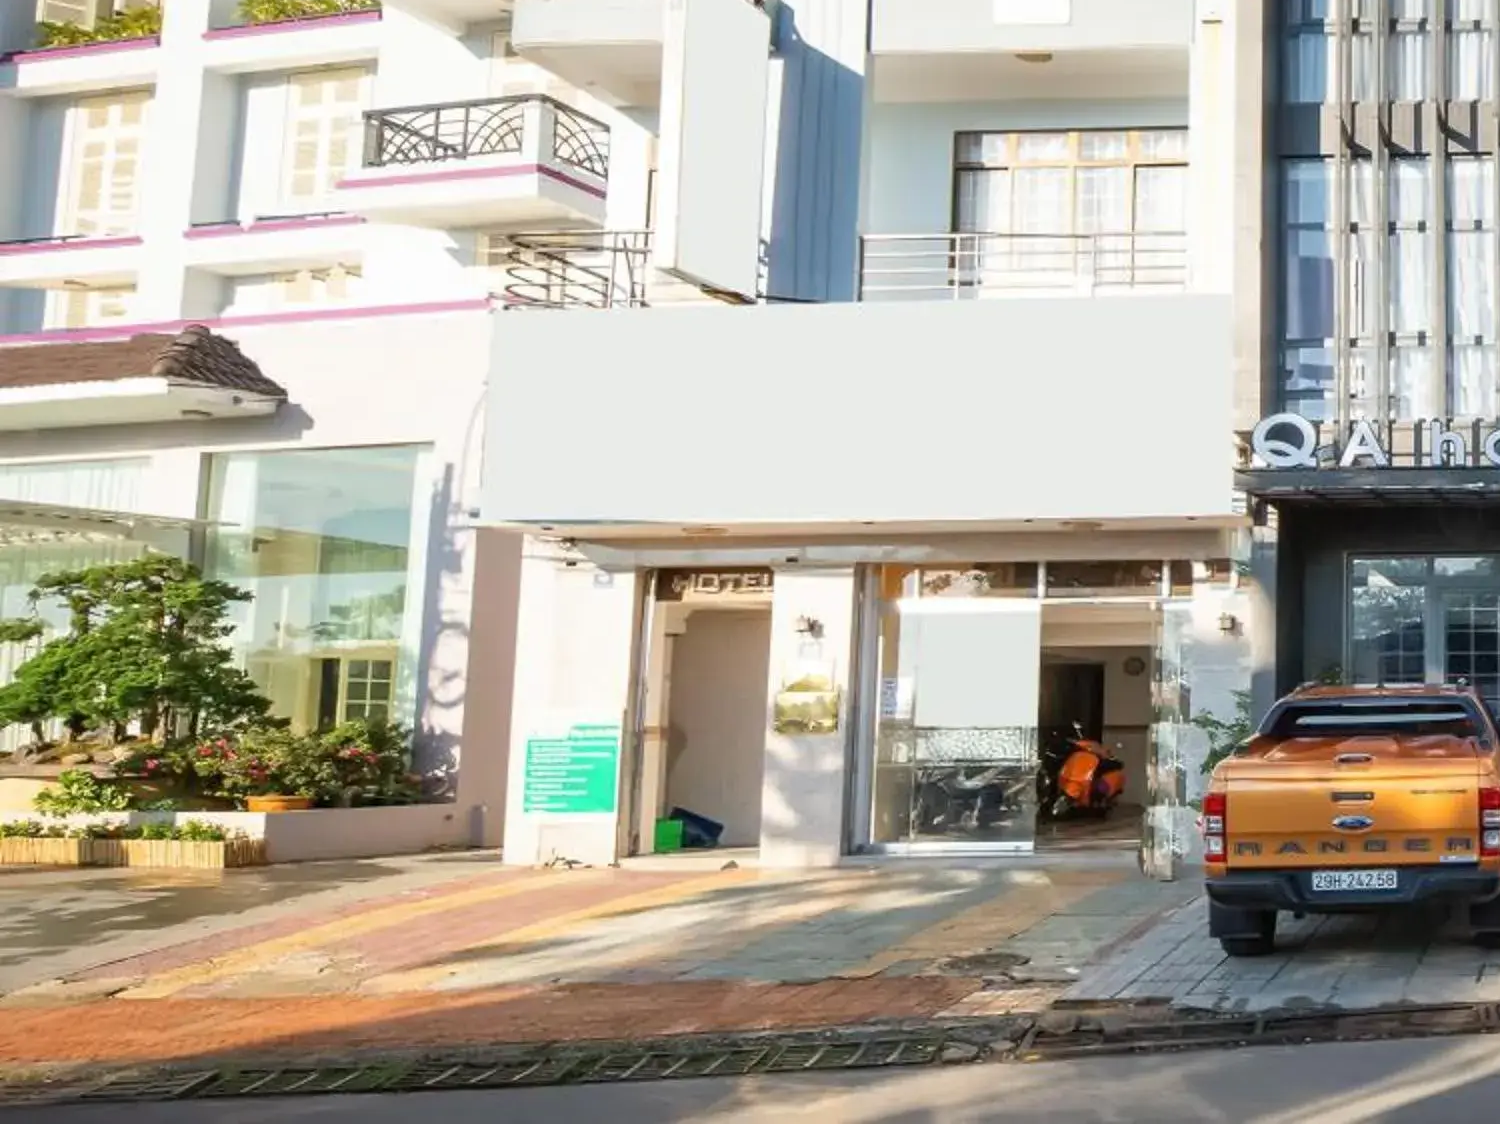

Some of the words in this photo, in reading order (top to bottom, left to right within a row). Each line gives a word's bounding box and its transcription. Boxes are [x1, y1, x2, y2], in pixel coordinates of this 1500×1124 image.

[1251, 413, 1391, 468] QA
[671, 573, 772, 593] HOTEL
[1233, 837, 1473, 856] RANGER
